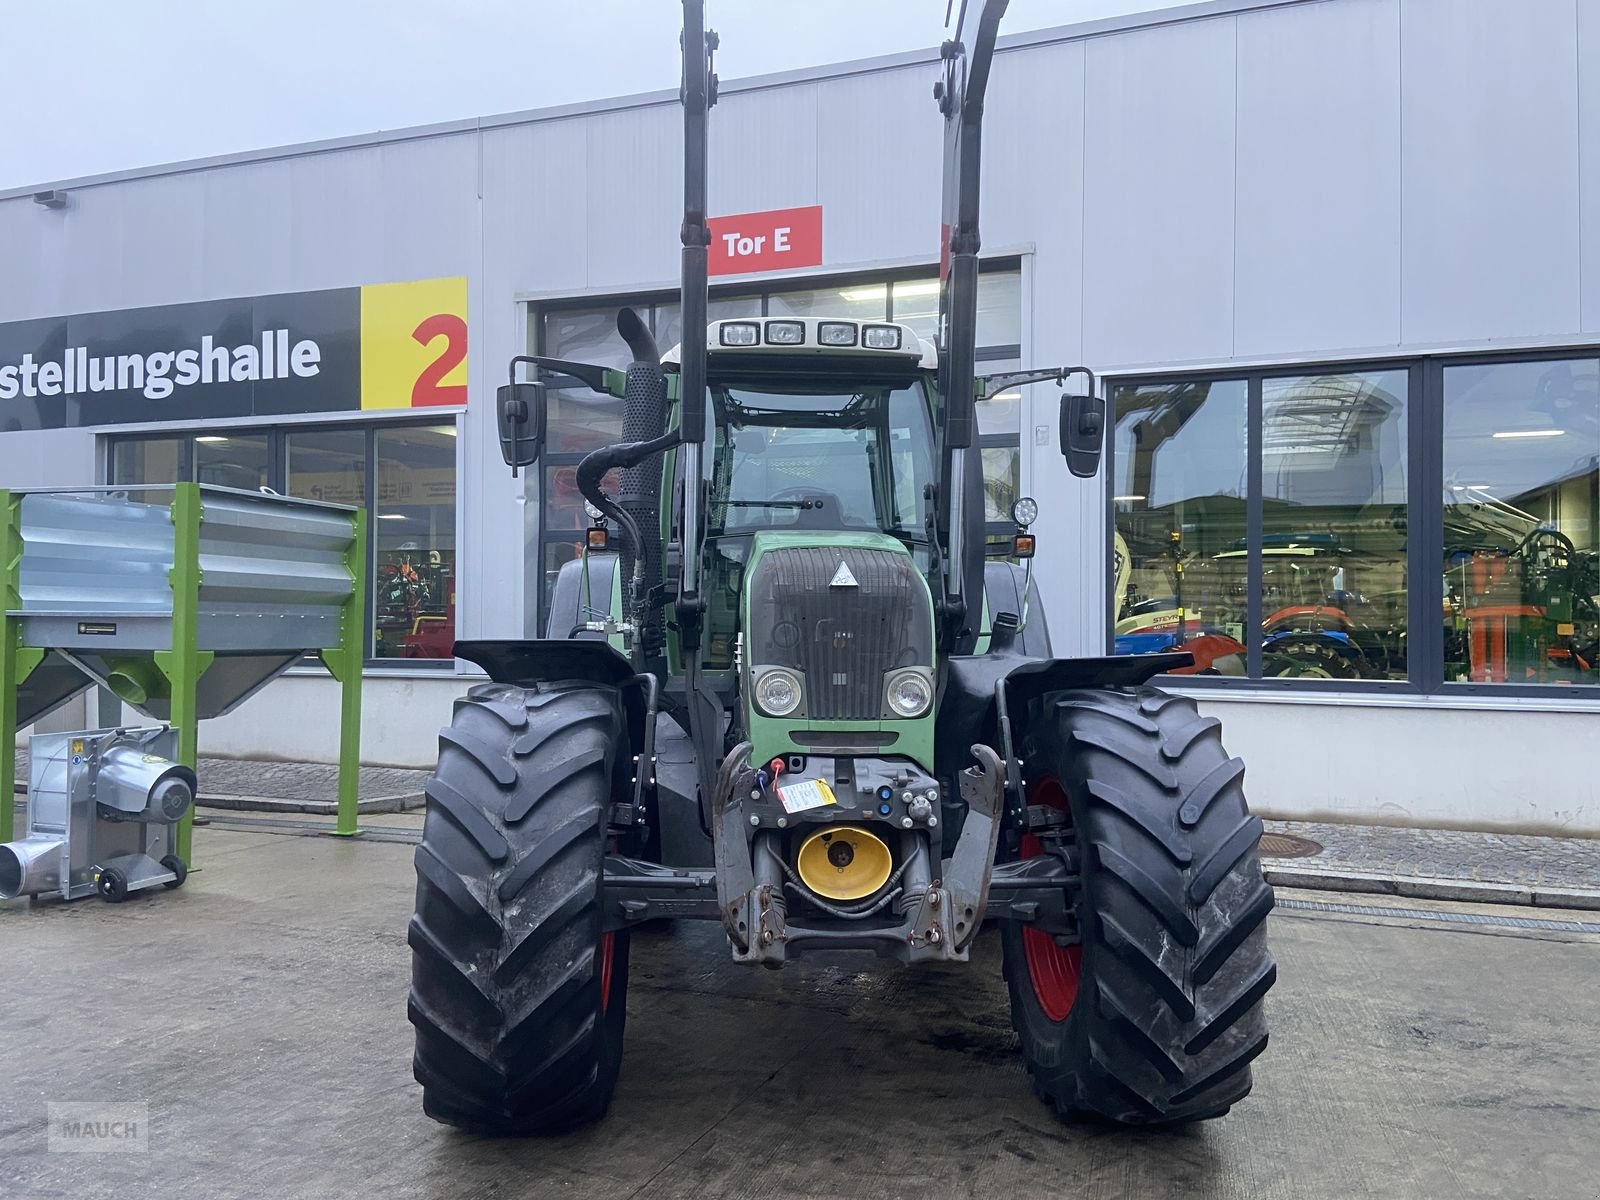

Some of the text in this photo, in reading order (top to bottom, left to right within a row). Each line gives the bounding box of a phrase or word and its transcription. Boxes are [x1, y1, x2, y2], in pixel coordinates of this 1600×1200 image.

[722, 227, 791, 257] Tor E
[0, 313, 467, 408] stellungshalle 2
